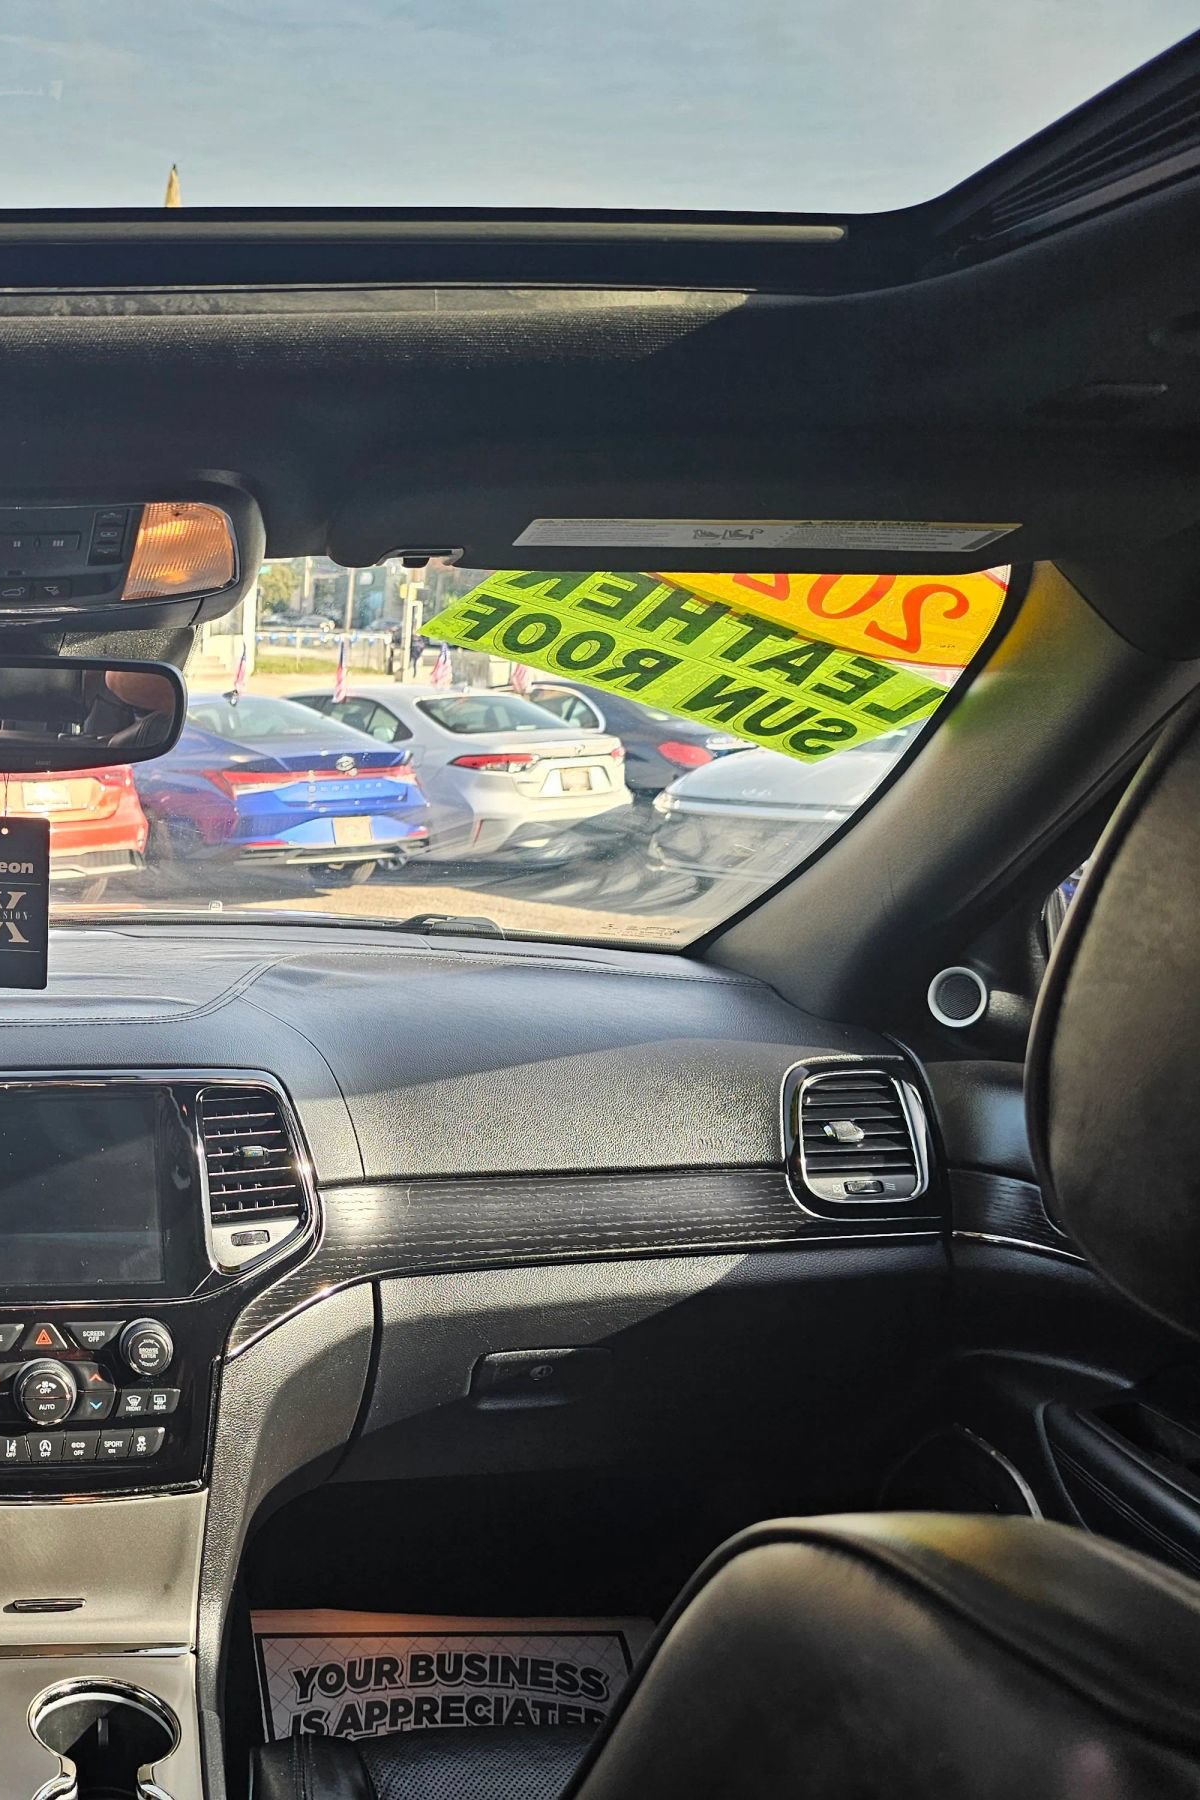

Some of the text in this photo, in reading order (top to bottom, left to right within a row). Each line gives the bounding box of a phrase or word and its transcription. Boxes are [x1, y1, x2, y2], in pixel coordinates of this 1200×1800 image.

[40, 1387, 52, 1395] OFF
[38, 1403, 55, 1411] AUTO
[291, 1652, 610, 1703] YOUR BUSINESS
